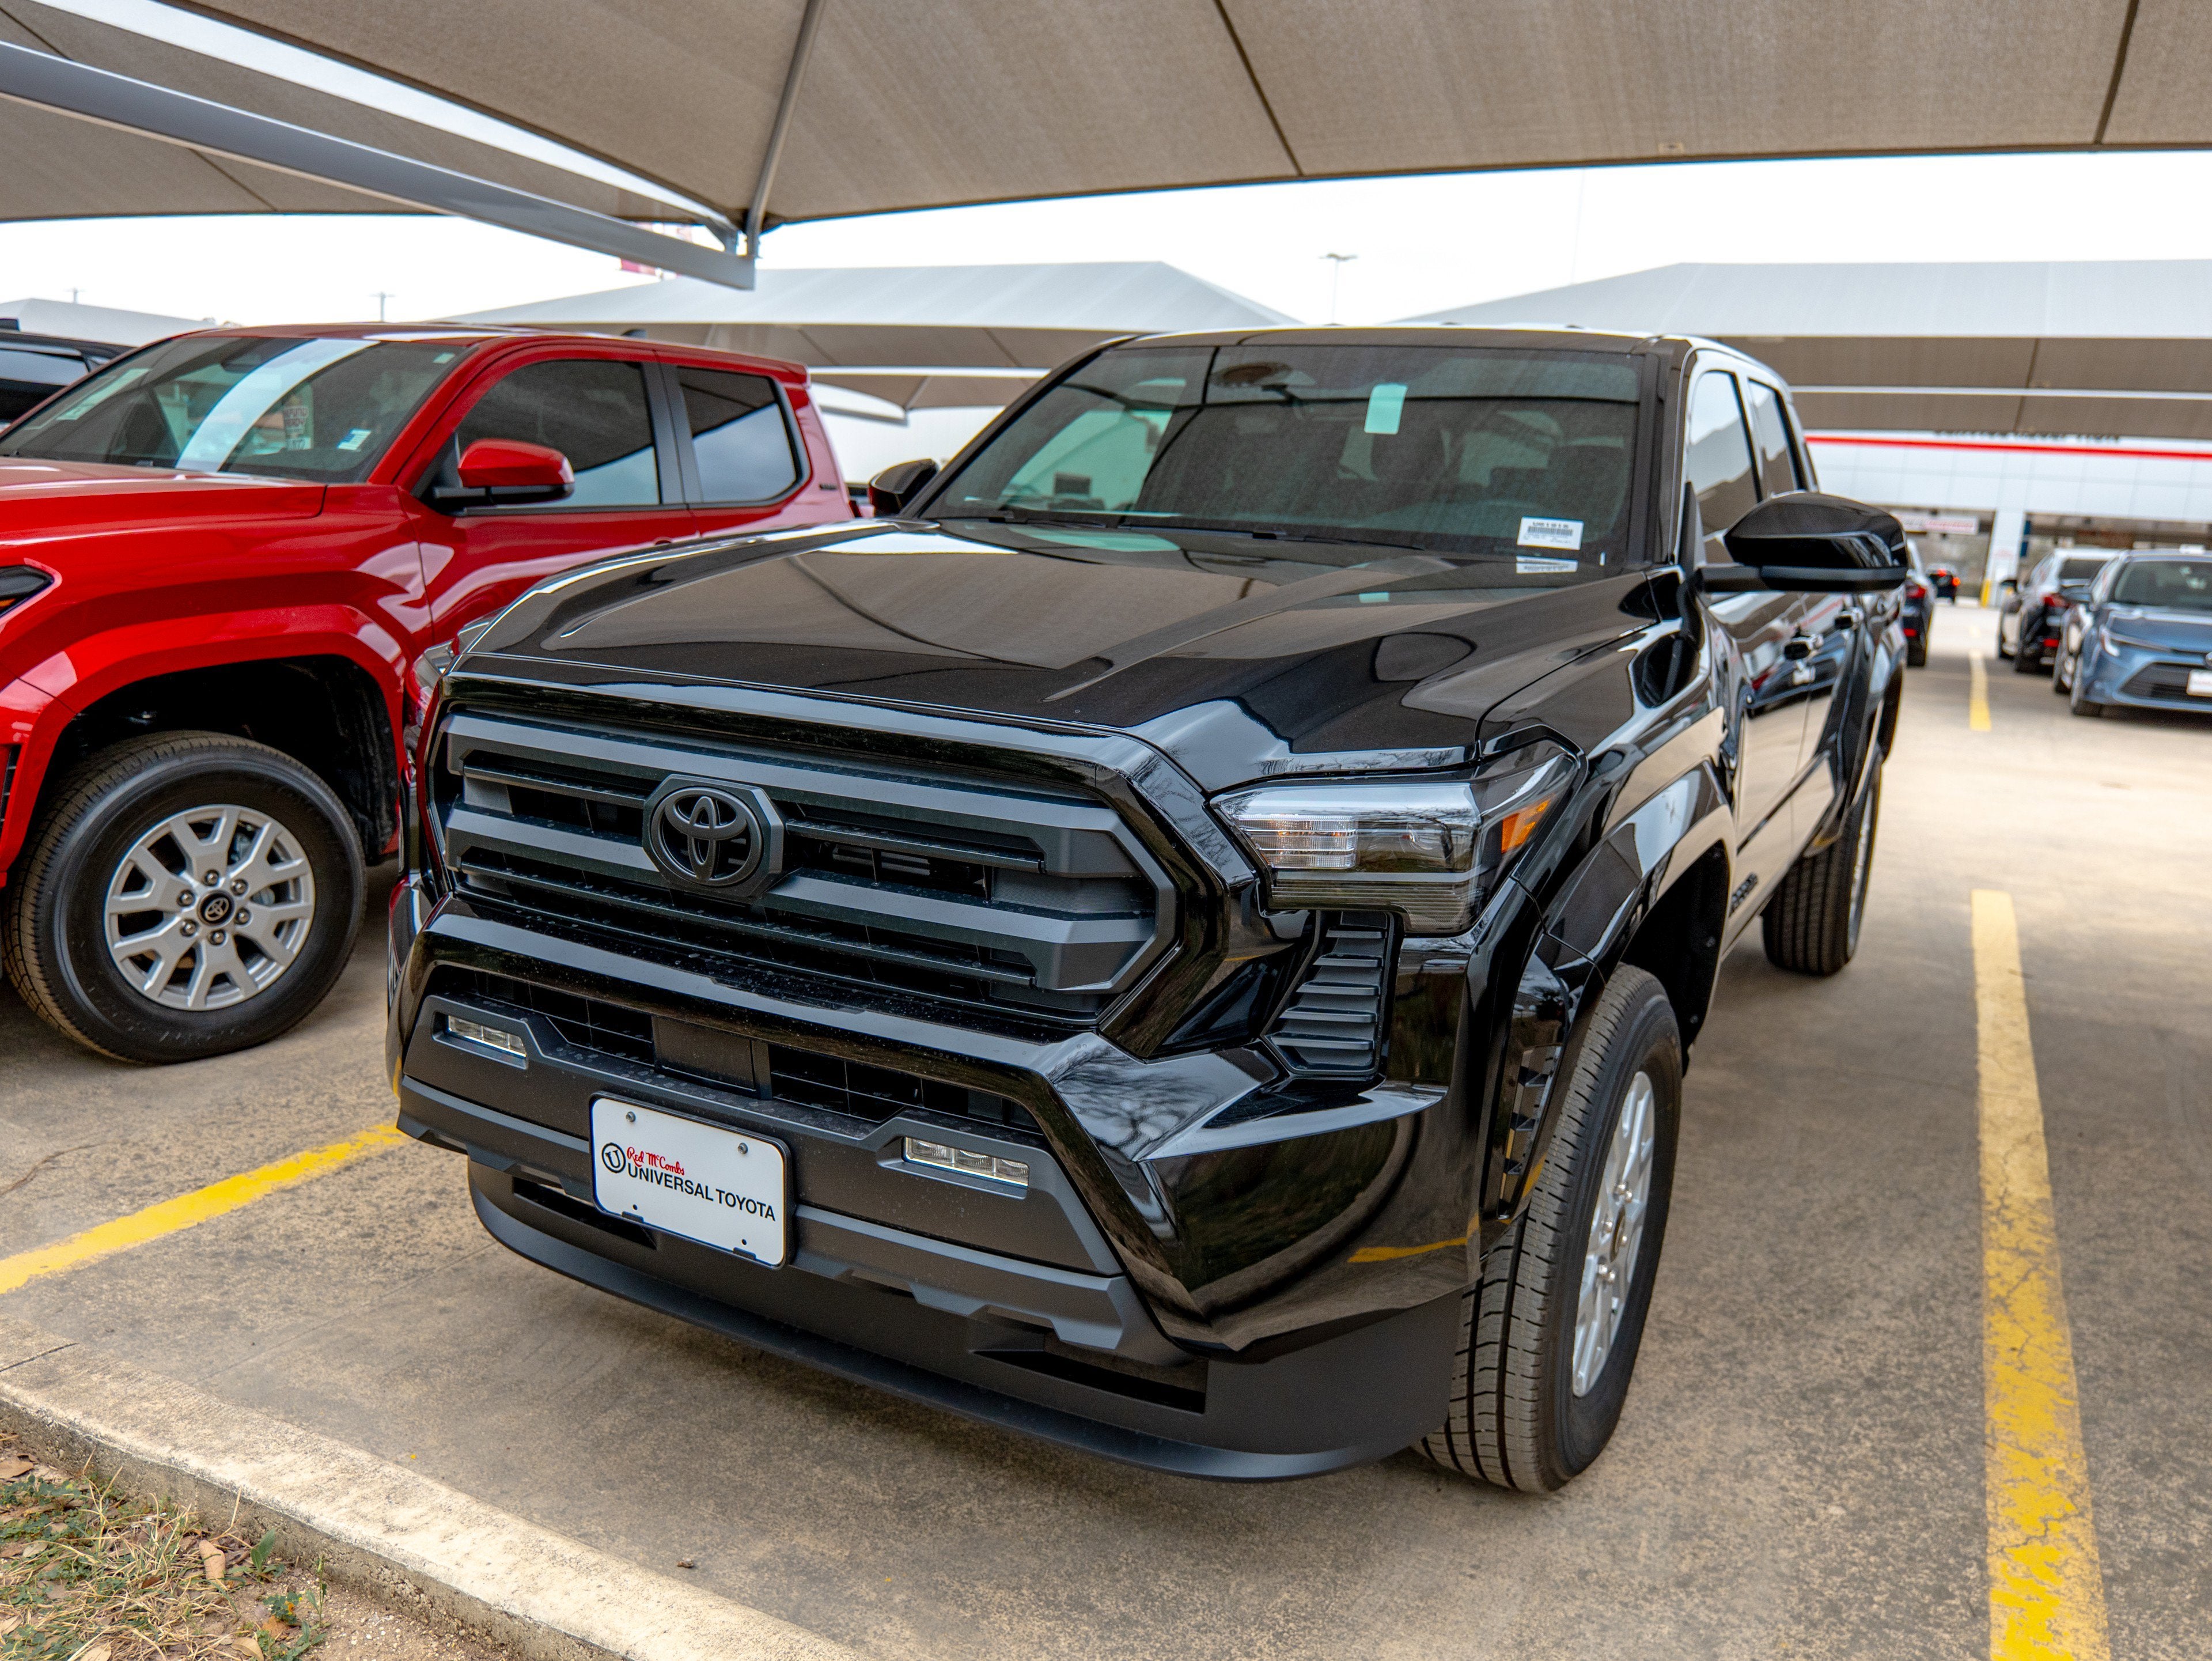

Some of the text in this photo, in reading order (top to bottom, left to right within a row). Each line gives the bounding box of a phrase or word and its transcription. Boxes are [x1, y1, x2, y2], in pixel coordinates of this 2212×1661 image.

[627, 1147, 685, 1176] Red McCombs
[627, 1162, 775, 1221] UNIVERSAL TOYOTA
